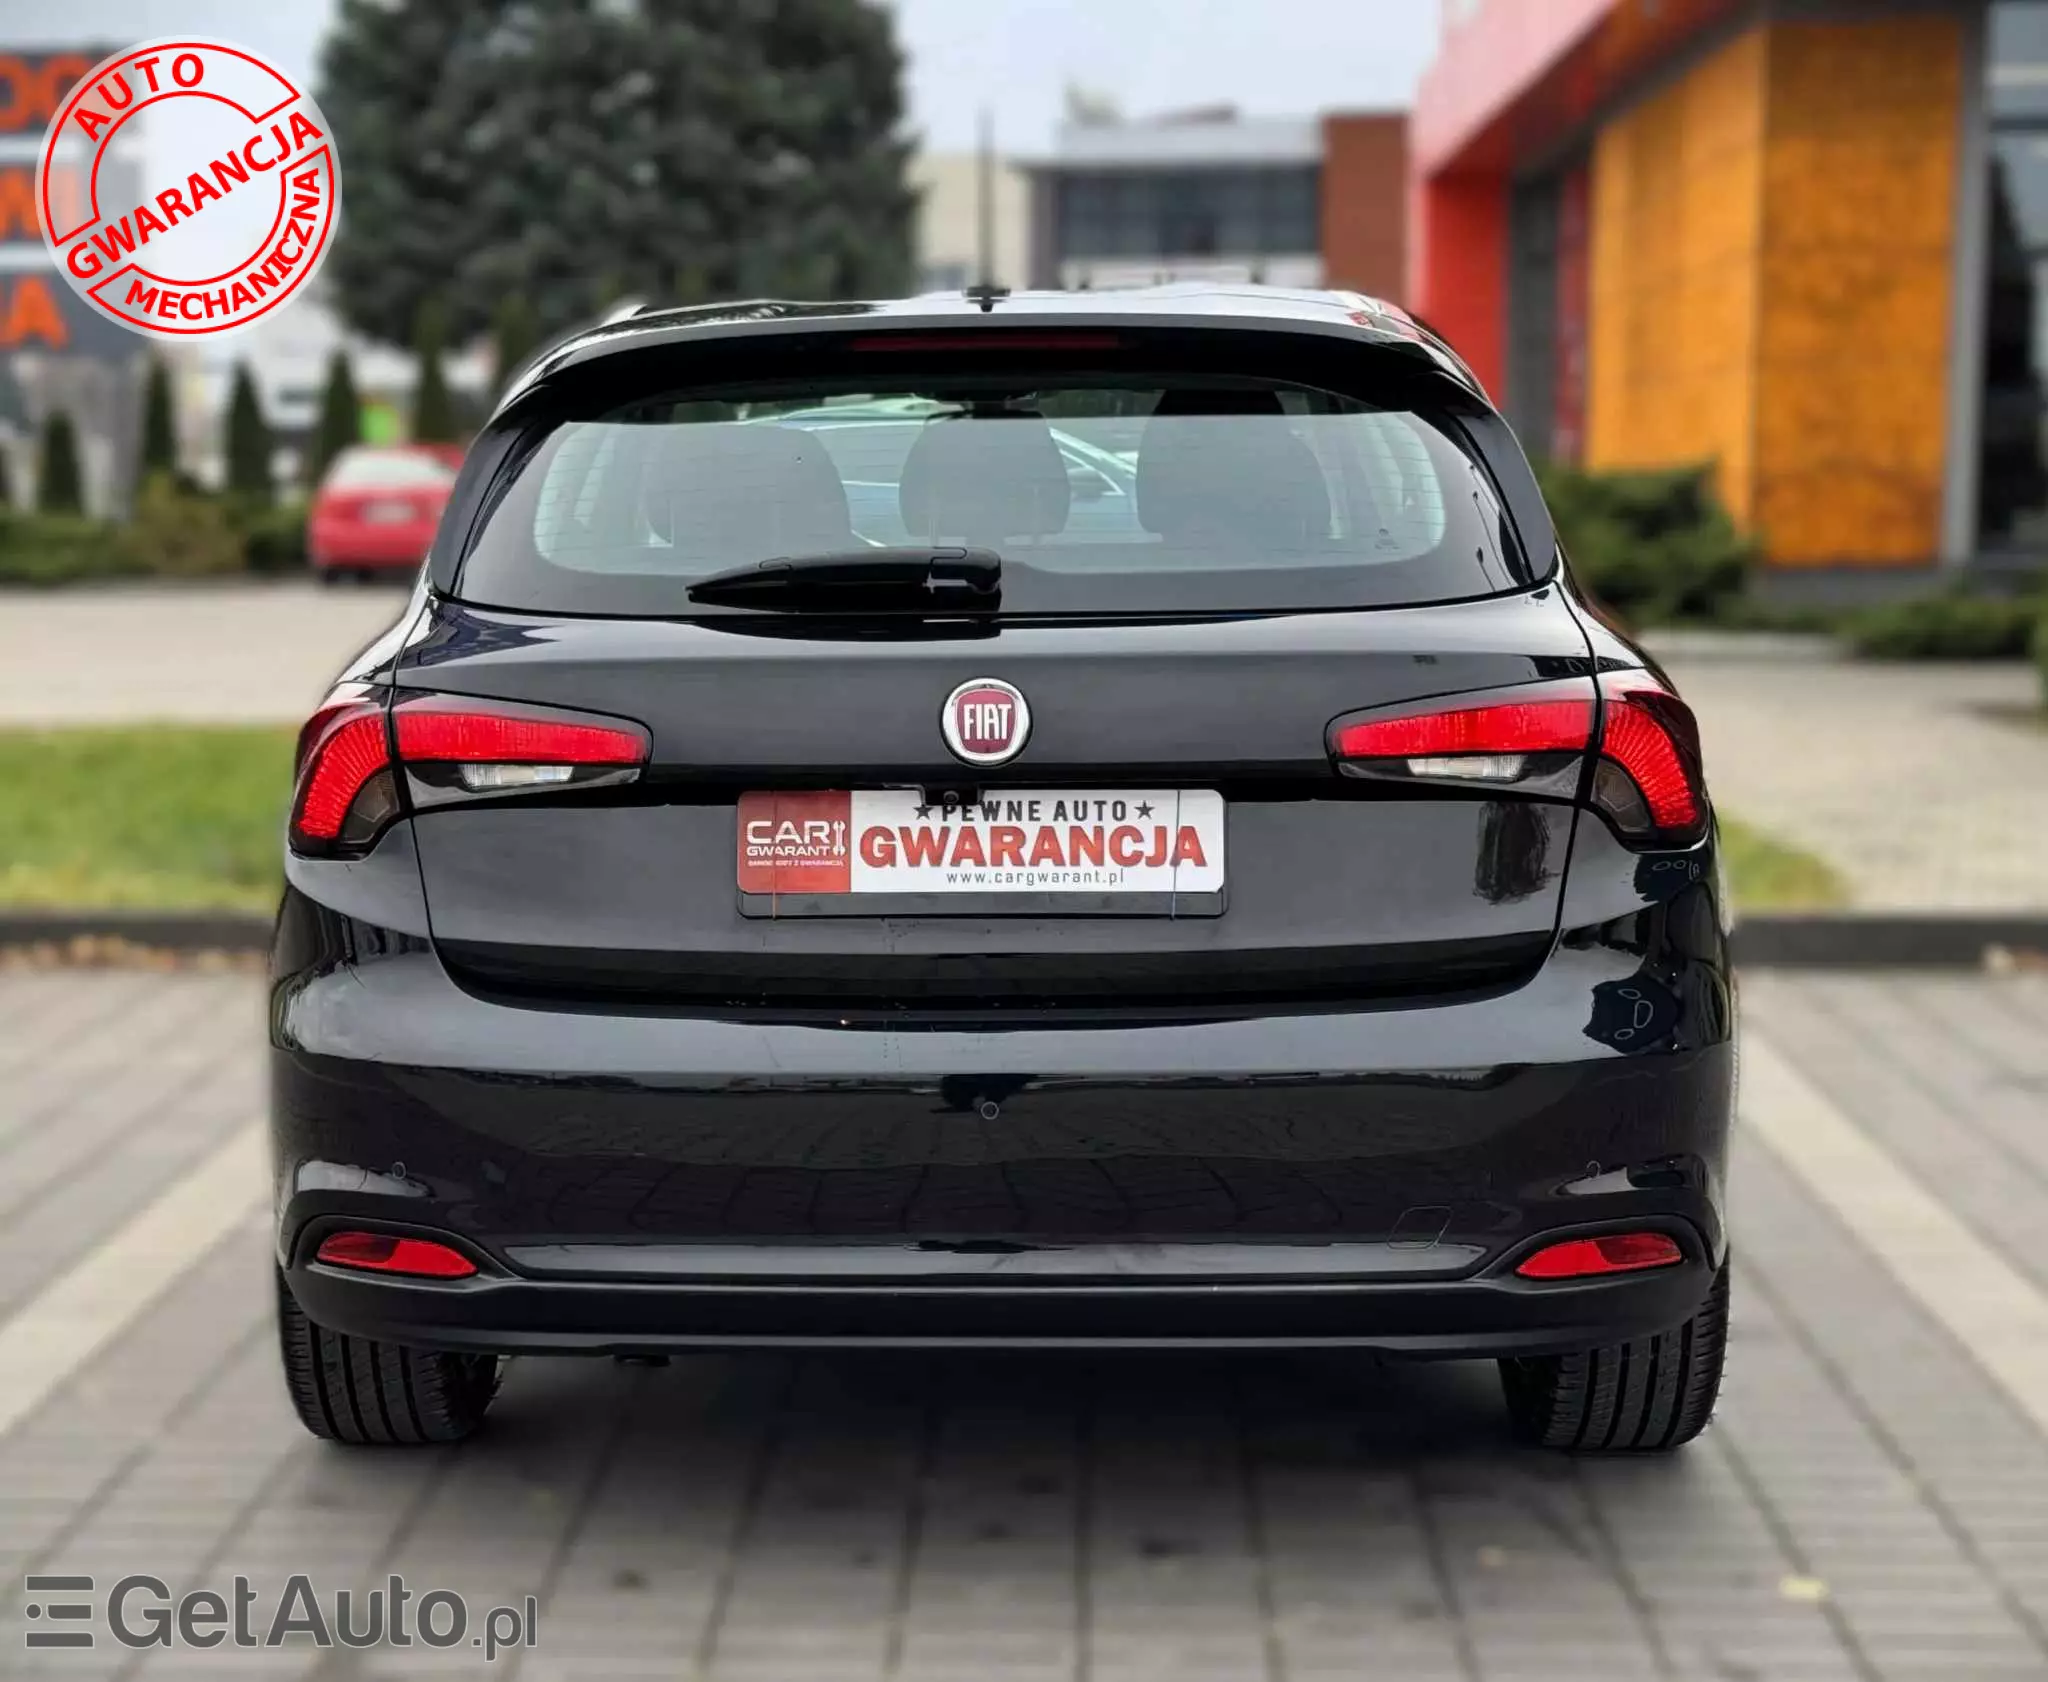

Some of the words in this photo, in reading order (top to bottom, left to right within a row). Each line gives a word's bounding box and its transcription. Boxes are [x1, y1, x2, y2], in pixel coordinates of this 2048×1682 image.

[963, 703, 1012, 740] FIAT
[941, 800, 1042, 822] PEWNE
[1053, 800, 1127, 822] AUTO
[746, 820, 831, 844] CAR
[746, 845, 831, 857] GWARANT
[859, 825, 1208, 868] GWARANCJA
[946, 868, 1125, 887] www.cargwarant.pl
